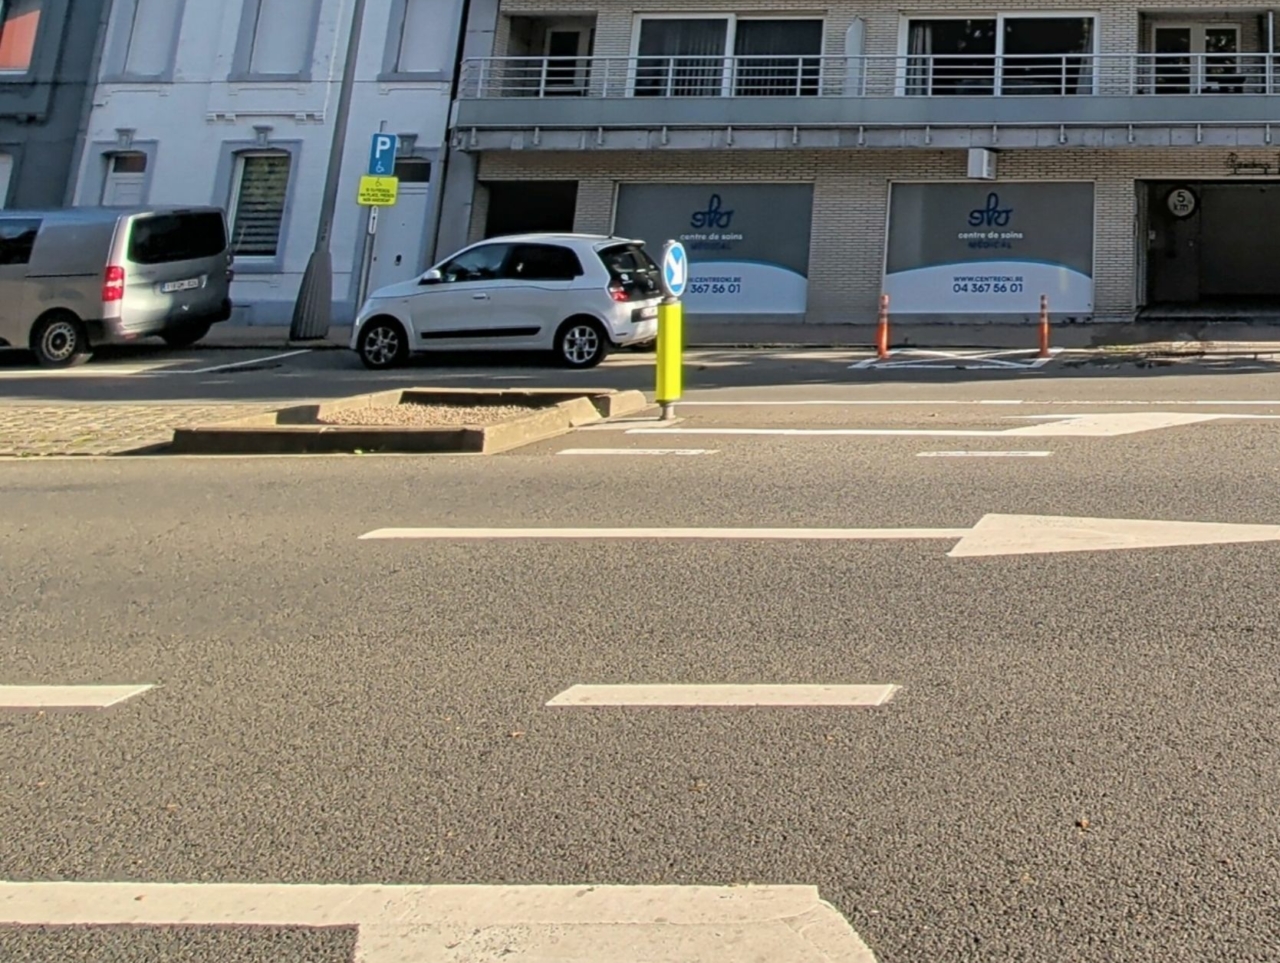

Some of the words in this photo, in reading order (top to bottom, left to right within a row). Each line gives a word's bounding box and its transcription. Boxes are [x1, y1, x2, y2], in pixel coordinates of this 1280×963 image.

[375, 136, 391, 159] P
[1177, 191, 1186, 204] 5
[709, 232, 719, 240] de
[721, 232, 743, 240] soins
[958, 231, 986, 239] centre
[987, 230, 999, 239] de
[1001, 230, 1023, 239] soins
[690, 283, 710, 294] 367
[711, 283, 726, 294] 56
[728, 283, 741, 294] 01
[953, 283, 968, 293] 04
[971, 283, 991, 293] 367
[993, 283, 1007, 293] 56
[1009, 283, 1023, 293] 01
